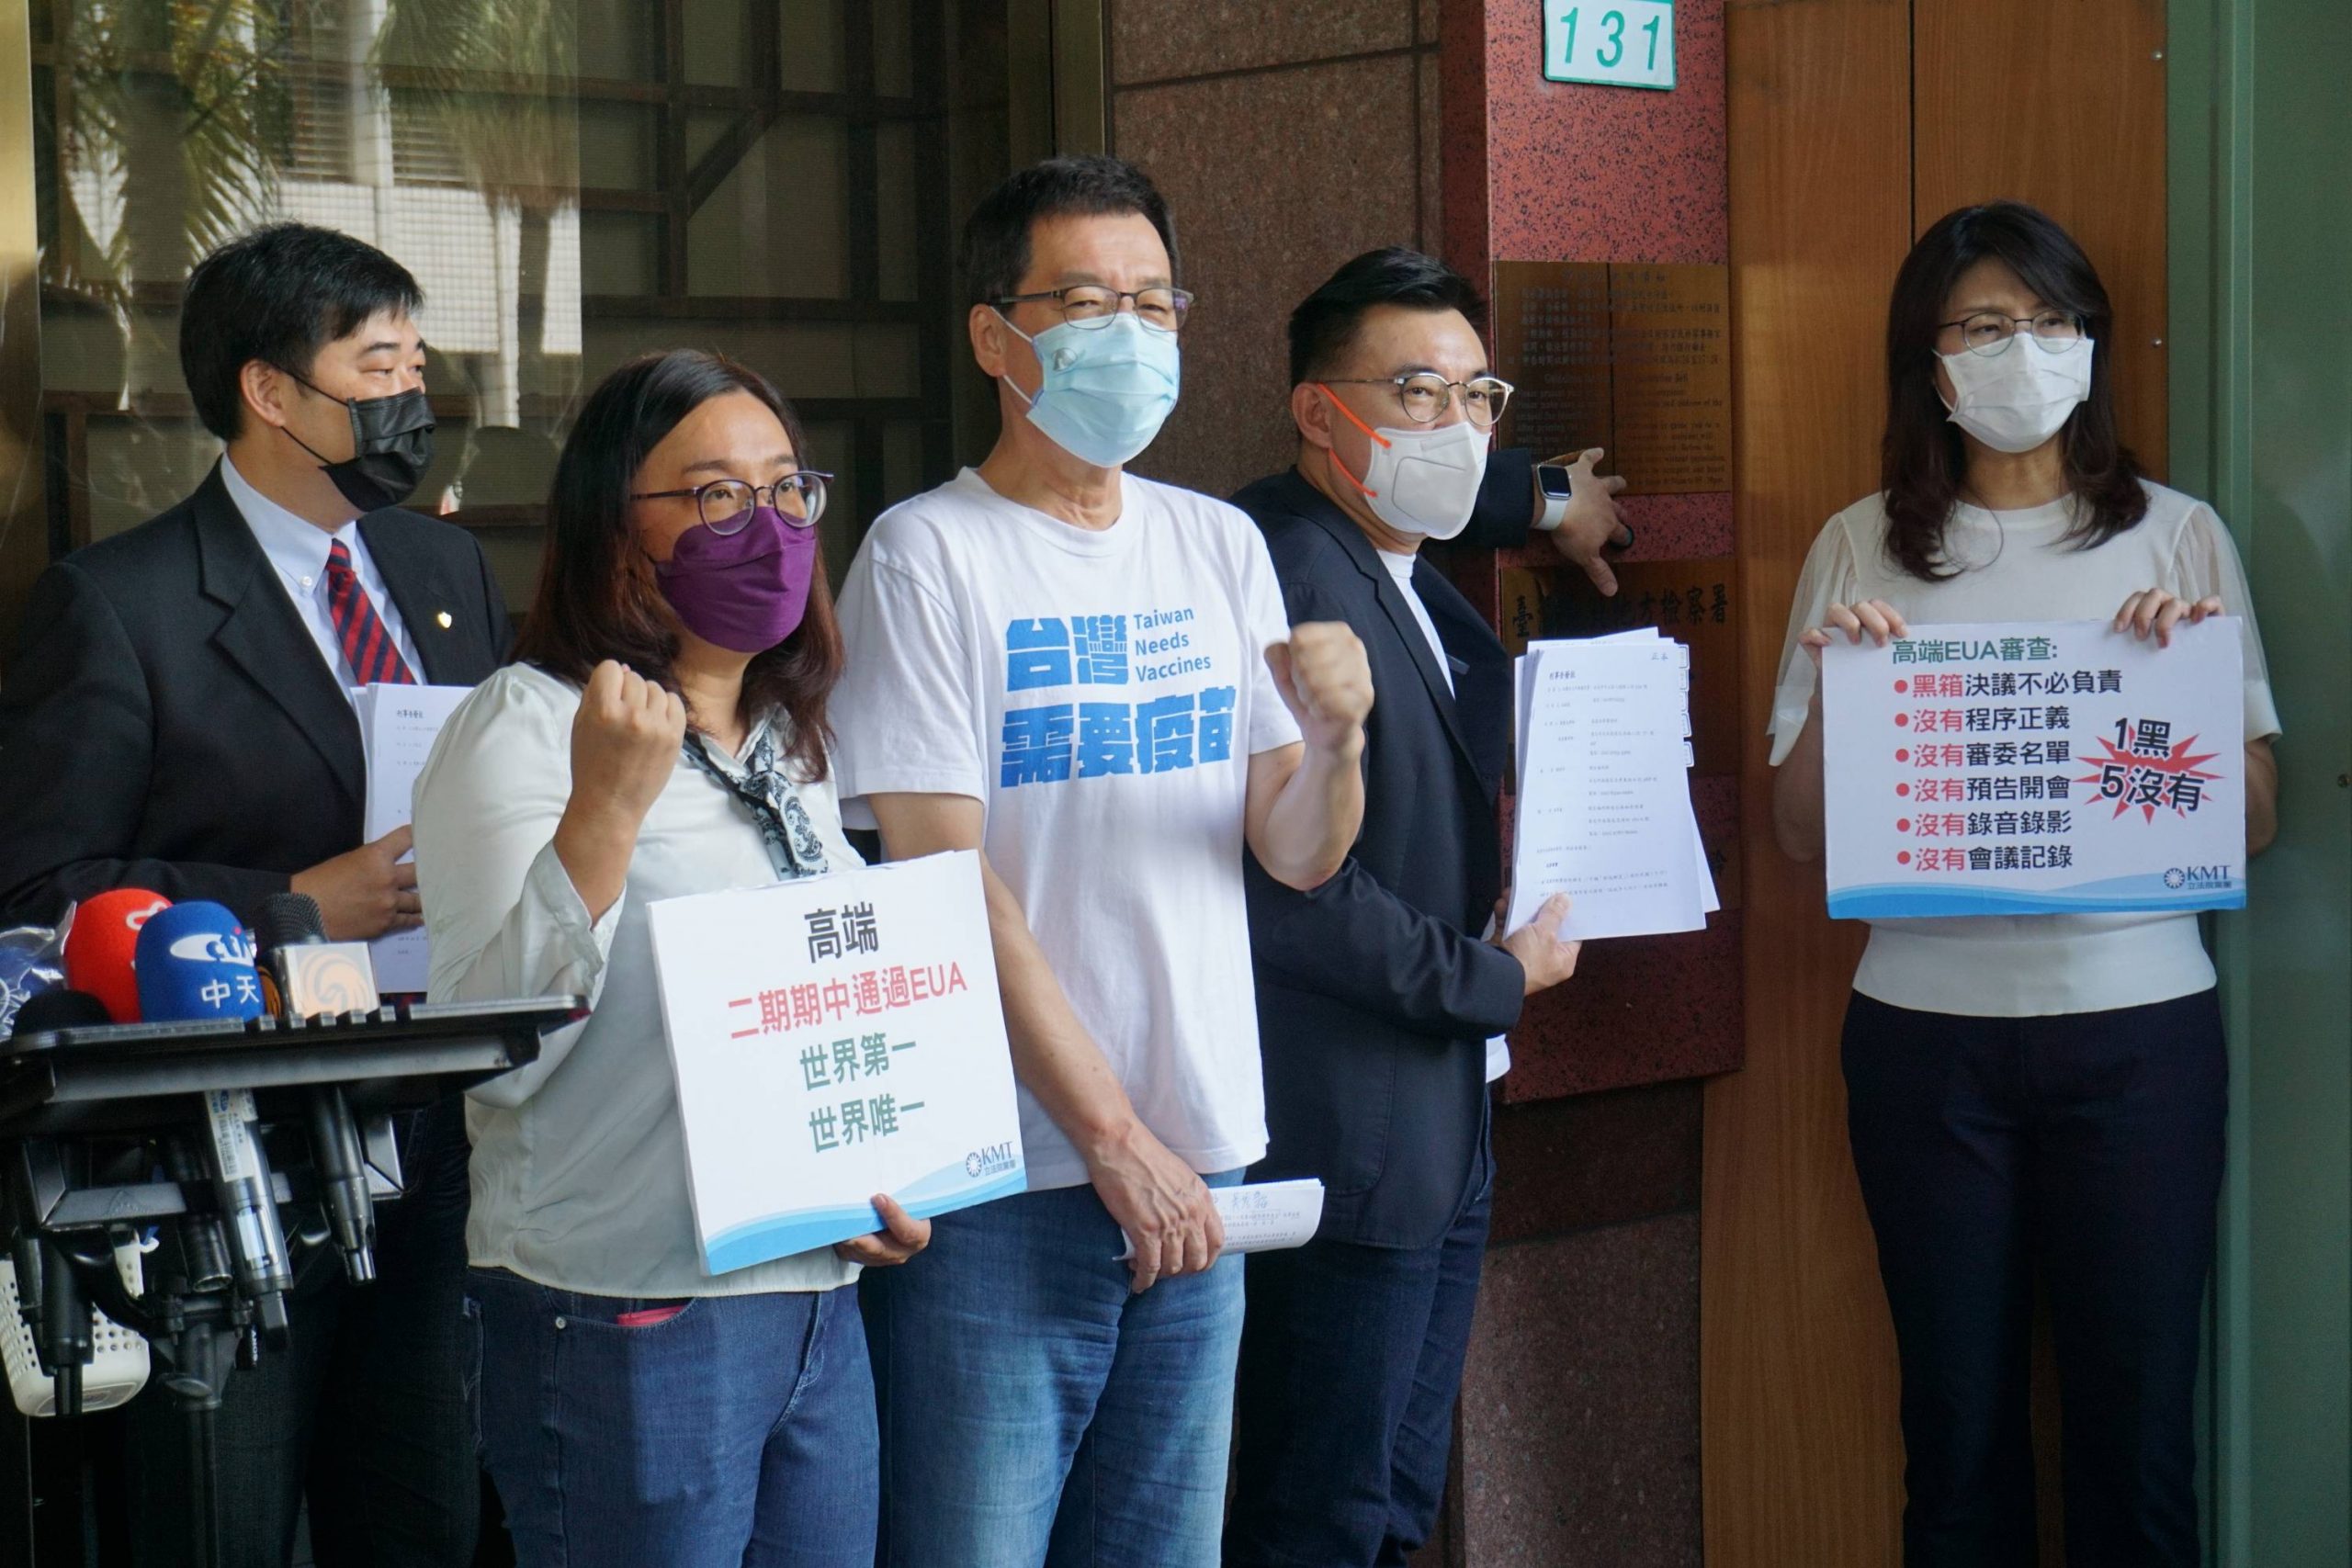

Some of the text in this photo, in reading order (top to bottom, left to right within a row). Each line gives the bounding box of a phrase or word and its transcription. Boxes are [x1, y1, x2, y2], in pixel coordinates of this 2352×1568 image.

[1560, 7, 1661, 71] 131
[1133, 607, 1194, 630] Taiwan
[1005, 615, 1129, 693] 台灣
[1135, 631, 1191, 656] Needs
[1892, 636, 2058, 664] 高端EUA審查:
[1135, 655, 1212, 682] Vaccines
[1912, 669, 2123, 698] 黑箱決議不必負責
[1913, 705, 2071, 733] 沒有程序正義
[1001, 685, 1237, 788] 需要疫苗
[2113, 717, 2171, 760] 1黑
[1913, 740, 2071, 768] 沒有審委名單
[1914, 775, 2071, 803] 沒有預告開會
[2100, 765, 2205, 813] 5沒有
[1915, 810, 2072, 838] 沒有錄音錄影
[1915, 845, 2073, 872] 沒有會議記錄
[2187, 865, 2232, 881] KMT
[804, 901, 879, 964] 高端
[201, 976, 260, 1009] 中天
[729, 961, 968, 1039] 二期期中通過EUA
[799, 1032, 917, 1091] 世界第一
[808, 1093, 925, 1153] 世界唯一
[981, 1141, 1013, 1166] KMT
